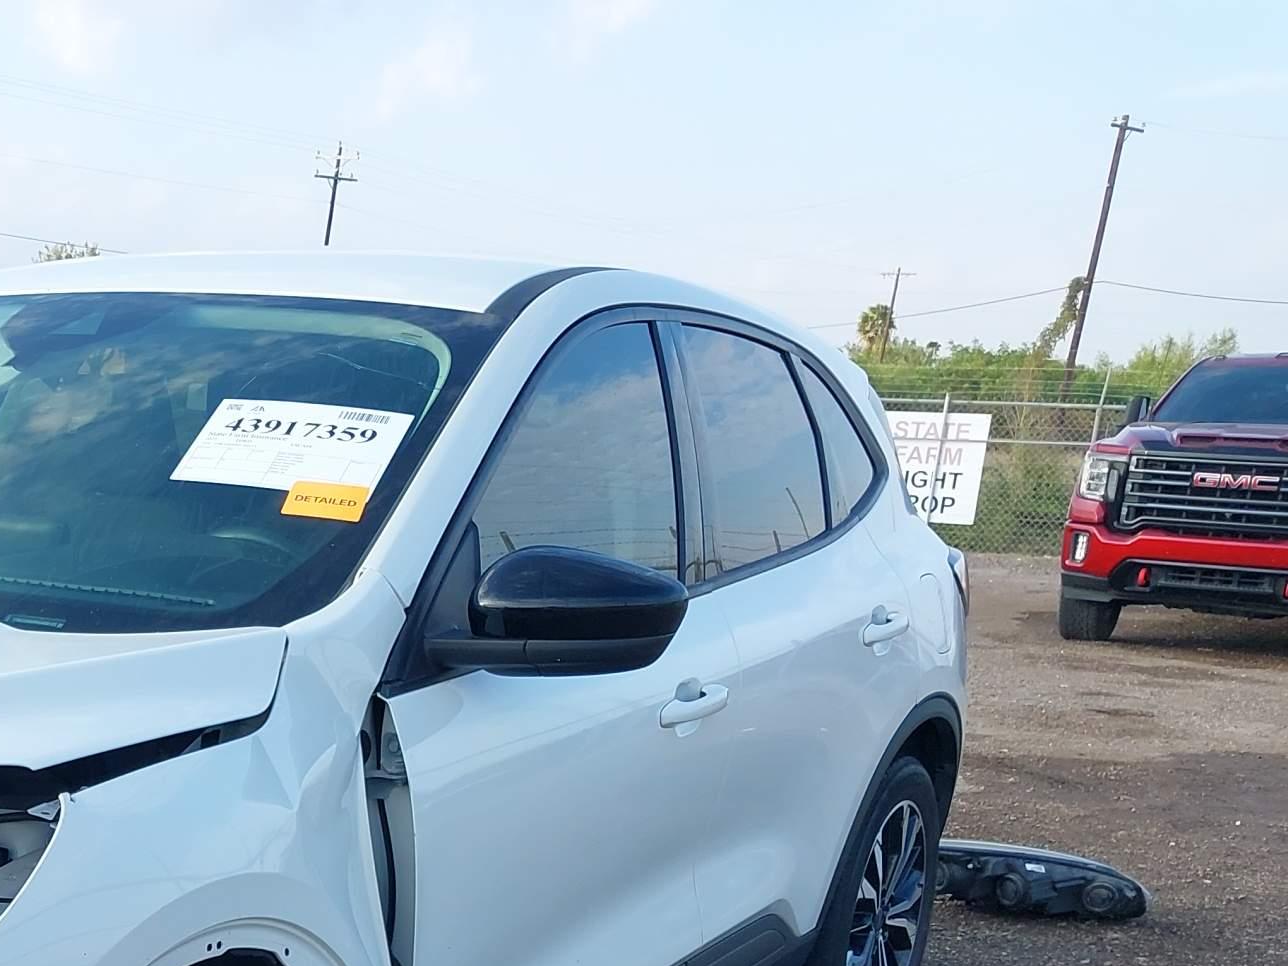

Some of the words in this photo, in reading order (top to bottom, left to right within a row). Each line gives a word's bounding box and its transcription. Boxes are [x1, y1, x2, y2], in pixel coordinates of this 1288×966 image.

[225, 417, 378, 443] 43917359
[895, 420, 972, 440] STATE
[896, 445, 964, 466] FARM
[1192, 472, 1280, 491] GMC
[294, 494, 358, 508] DETAILED
